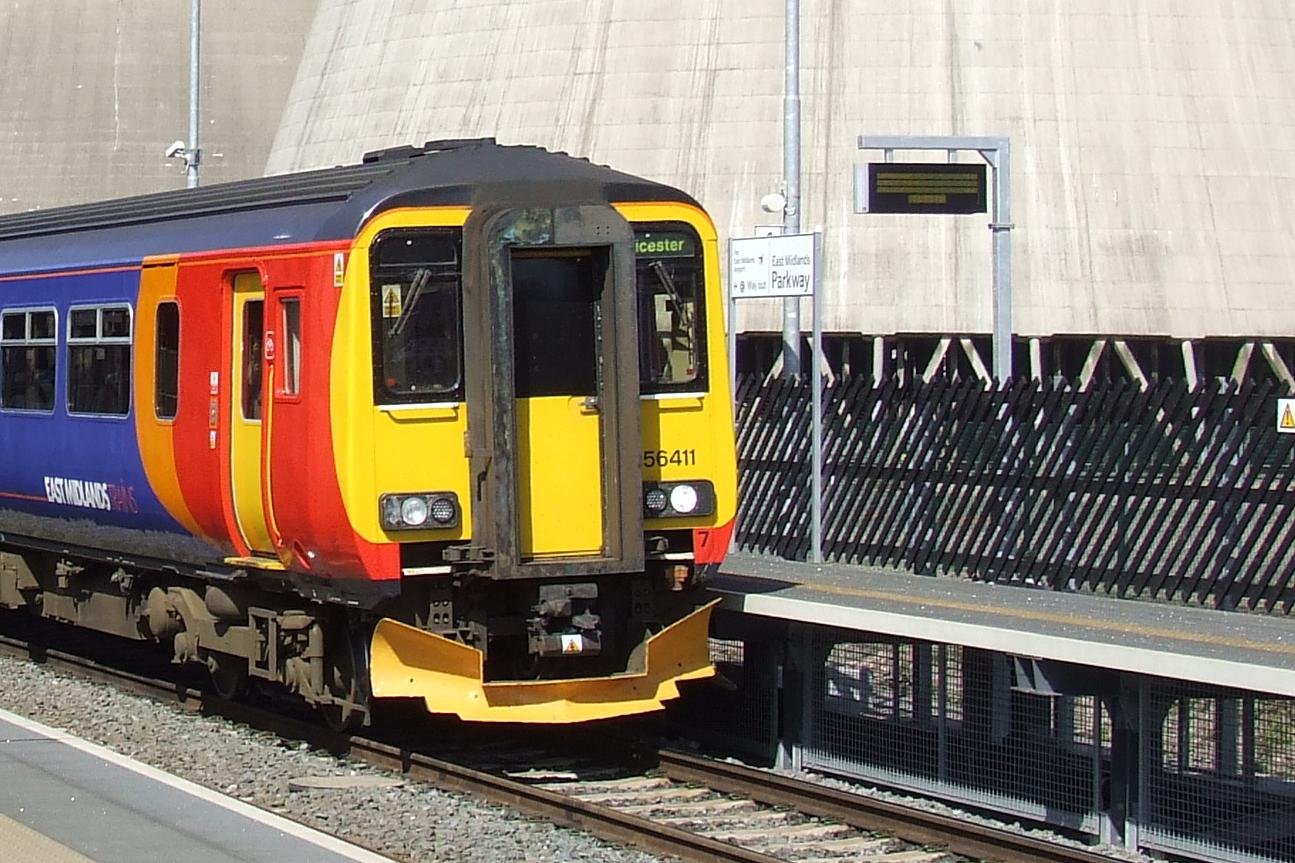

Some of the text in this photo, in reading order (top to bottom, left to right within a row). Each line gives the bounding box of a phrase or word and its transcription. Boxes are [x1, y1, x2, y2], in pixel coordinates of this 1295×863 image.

[771, 253, 811, 267] East Midlands
[771, 270, 810, 293] Parkway
[643, 449, 696, 468] 56411
[44, 476, 66, 504] EAST
[63, 478, 112, 512] MIDLANDS
[697, 531, 710, 548] 7
